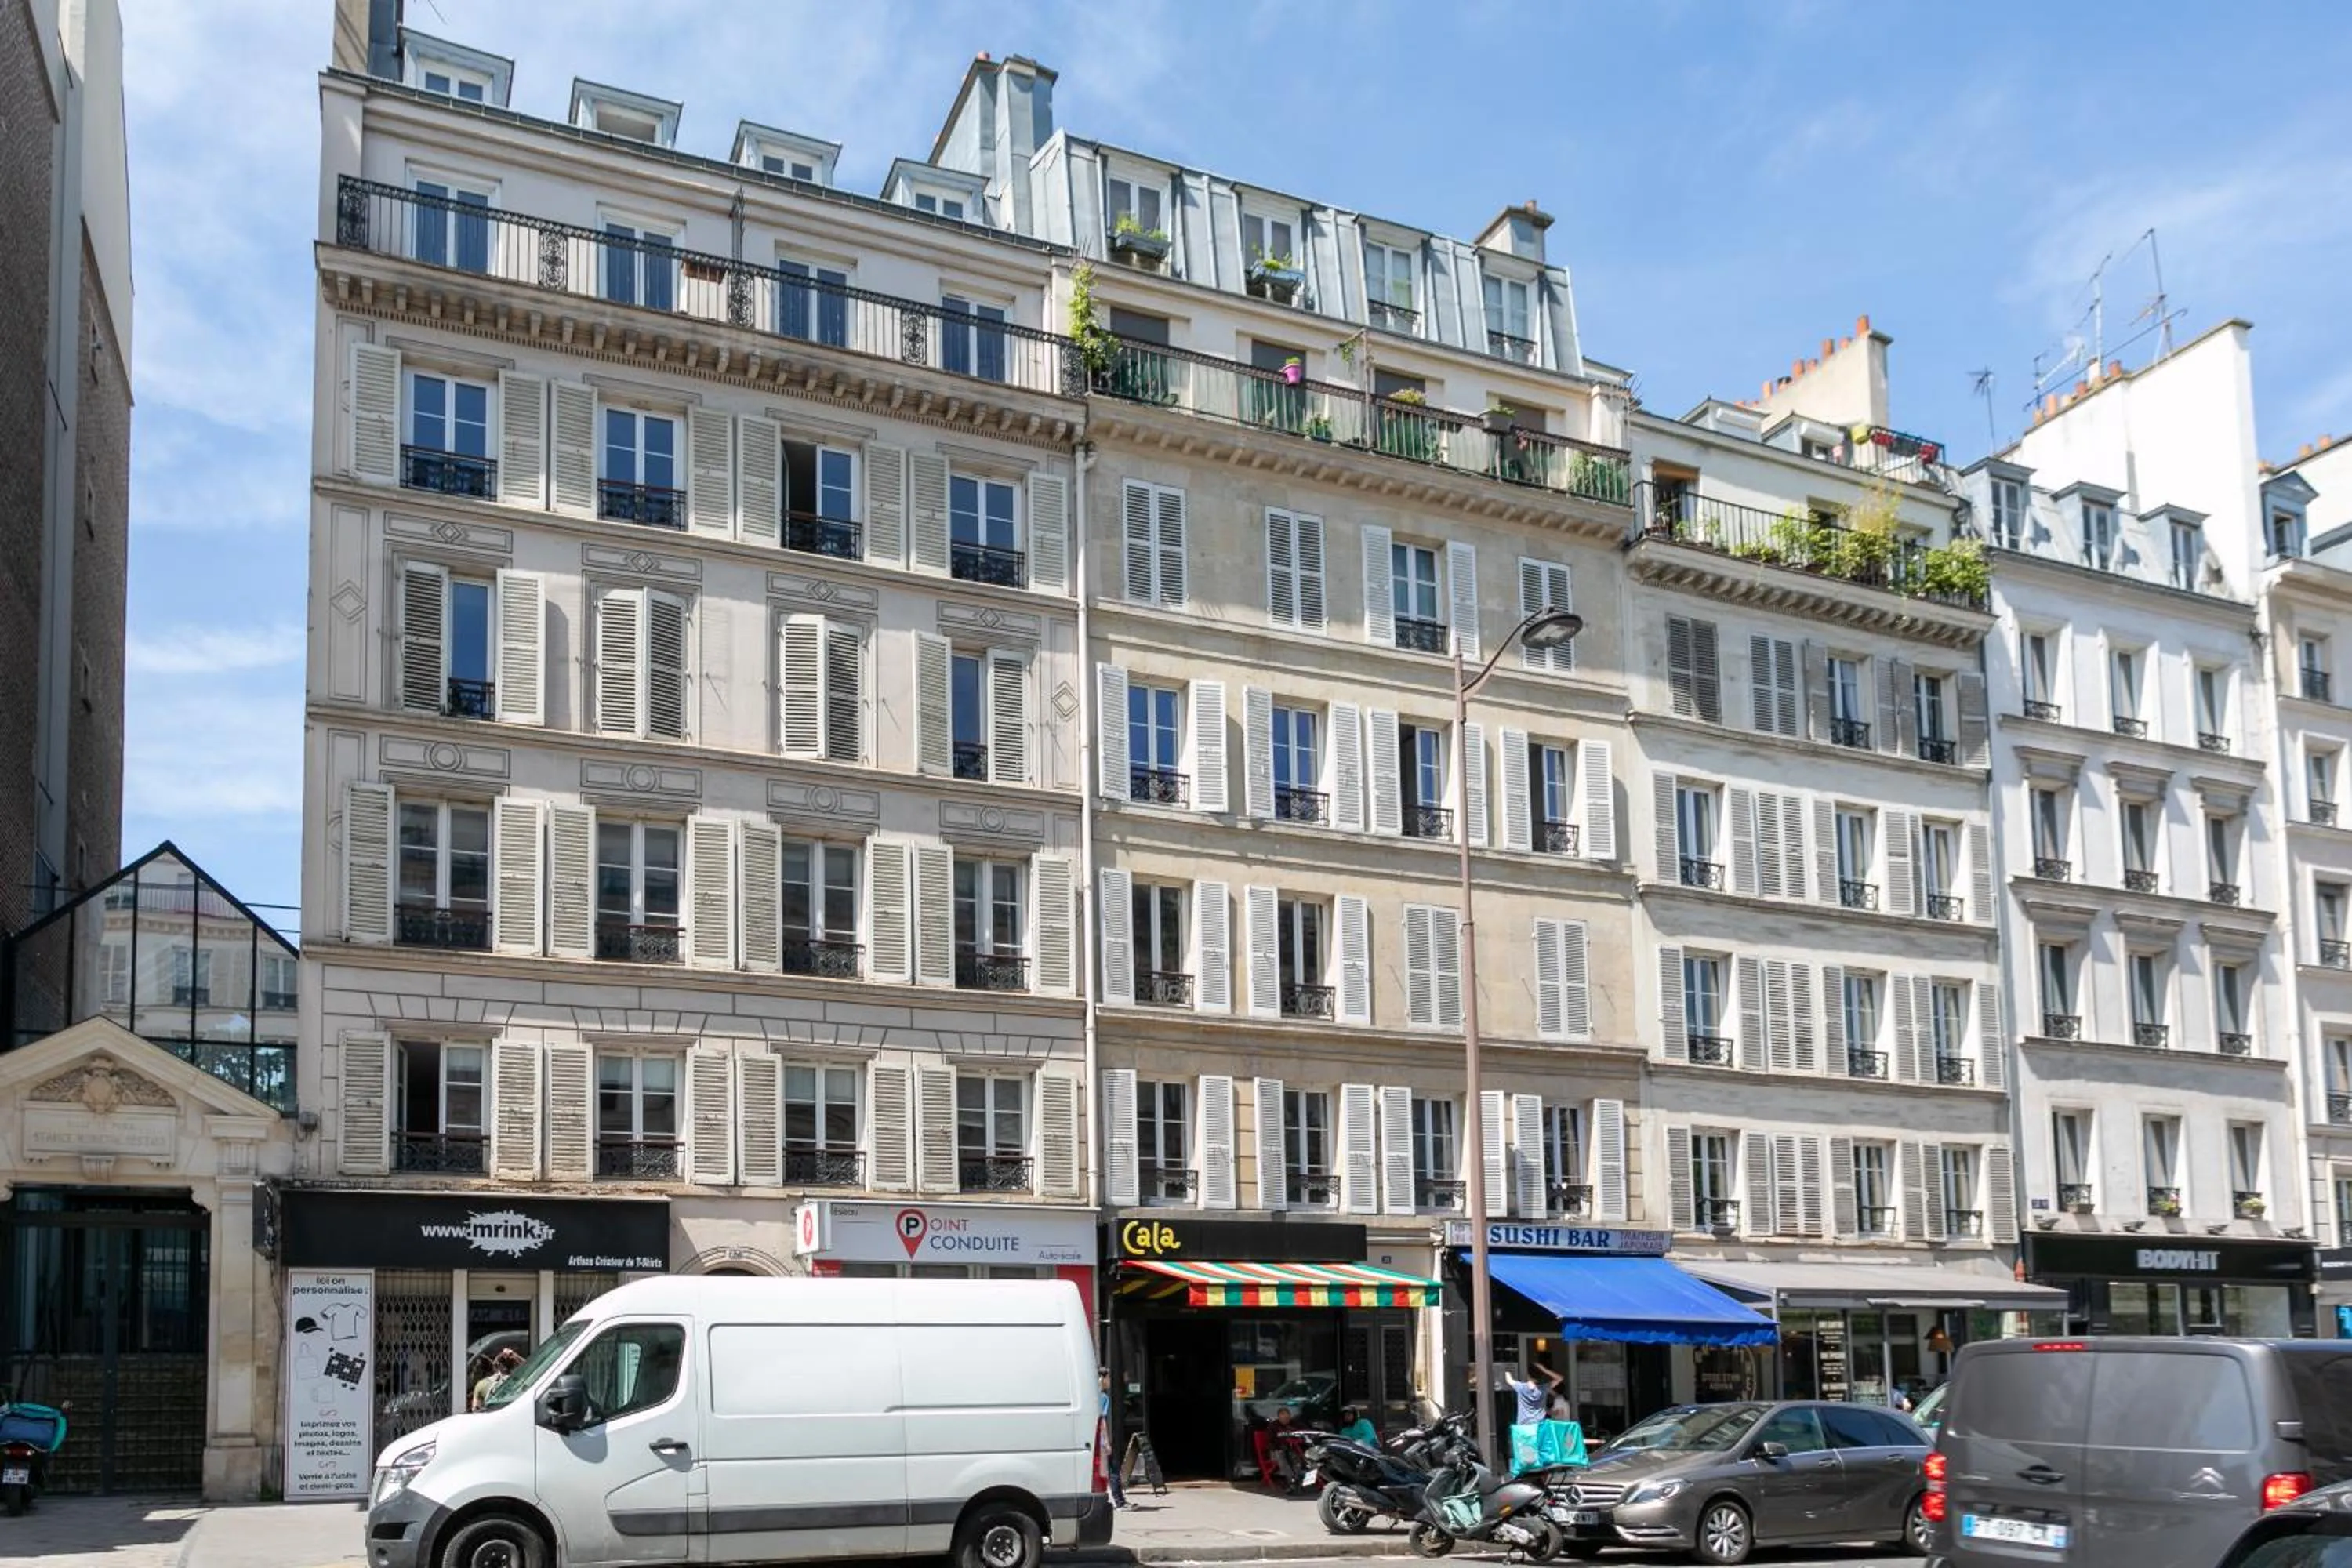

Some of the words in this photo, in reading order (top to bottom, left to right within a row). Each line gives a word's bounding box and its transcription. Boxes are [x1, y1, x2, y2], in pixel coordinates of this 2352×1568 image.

[421, 1219, 556, 1240] www.mrink.fr
[1123, 1221, 1181, 1255] Cala
[1489, 1225, 1560, 1247] SUSHI
[1567, 1228, 1610, 1248] BAR
[930, 1235, 1019, 1252] CONDUITE
[568, 1255, 593, 1266] Artisan
[626, 1256, 634, 1267] de
[636, 1257, 662, 1268] T-Shirts
[292, 1285, 363, 1295] personnalise
